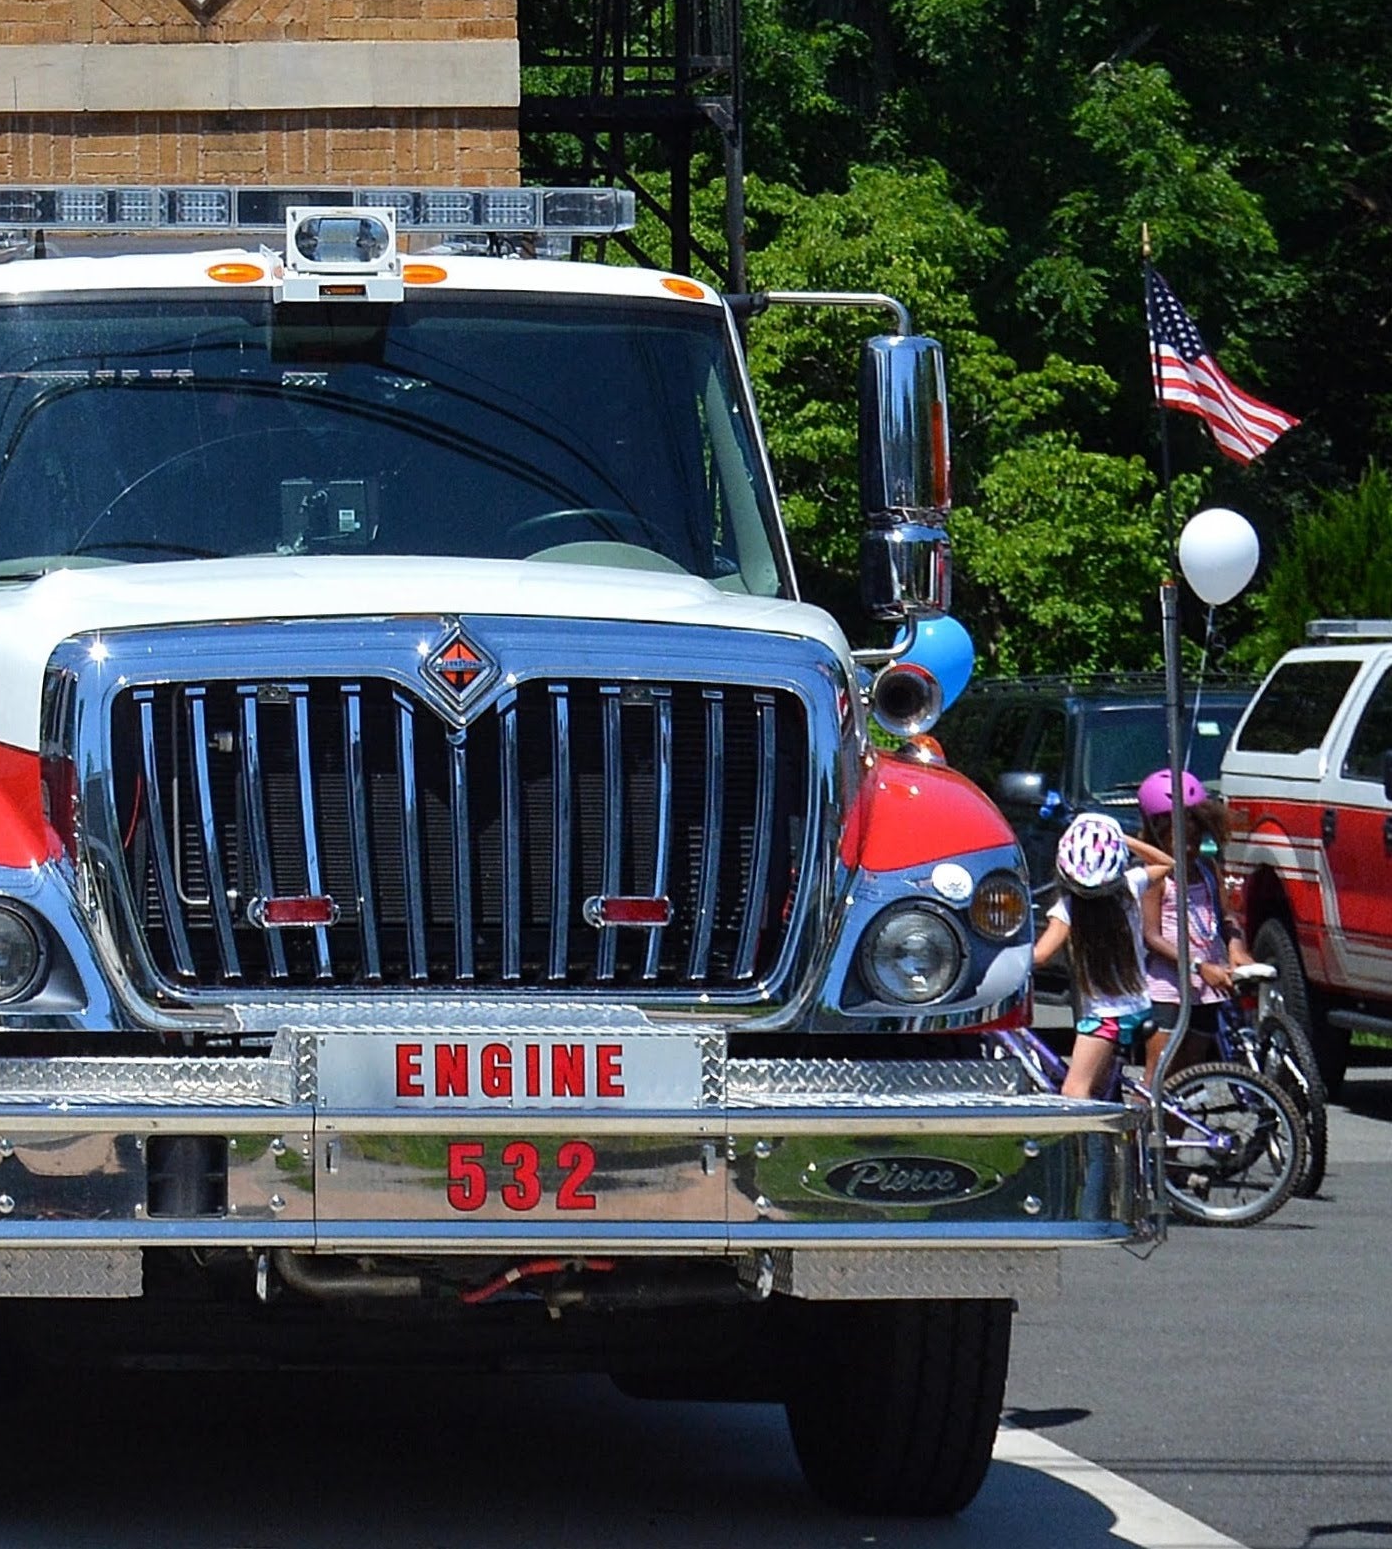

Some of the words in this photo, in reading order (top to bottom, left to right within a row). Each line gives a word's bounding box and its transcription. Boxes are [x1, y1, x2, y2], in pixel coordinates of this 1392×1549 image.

[395, 1042, 625, 1098] ENGINE
[446, 1140, 597, 1212] 532
[845, 1161, 959, 1197] Pierce
